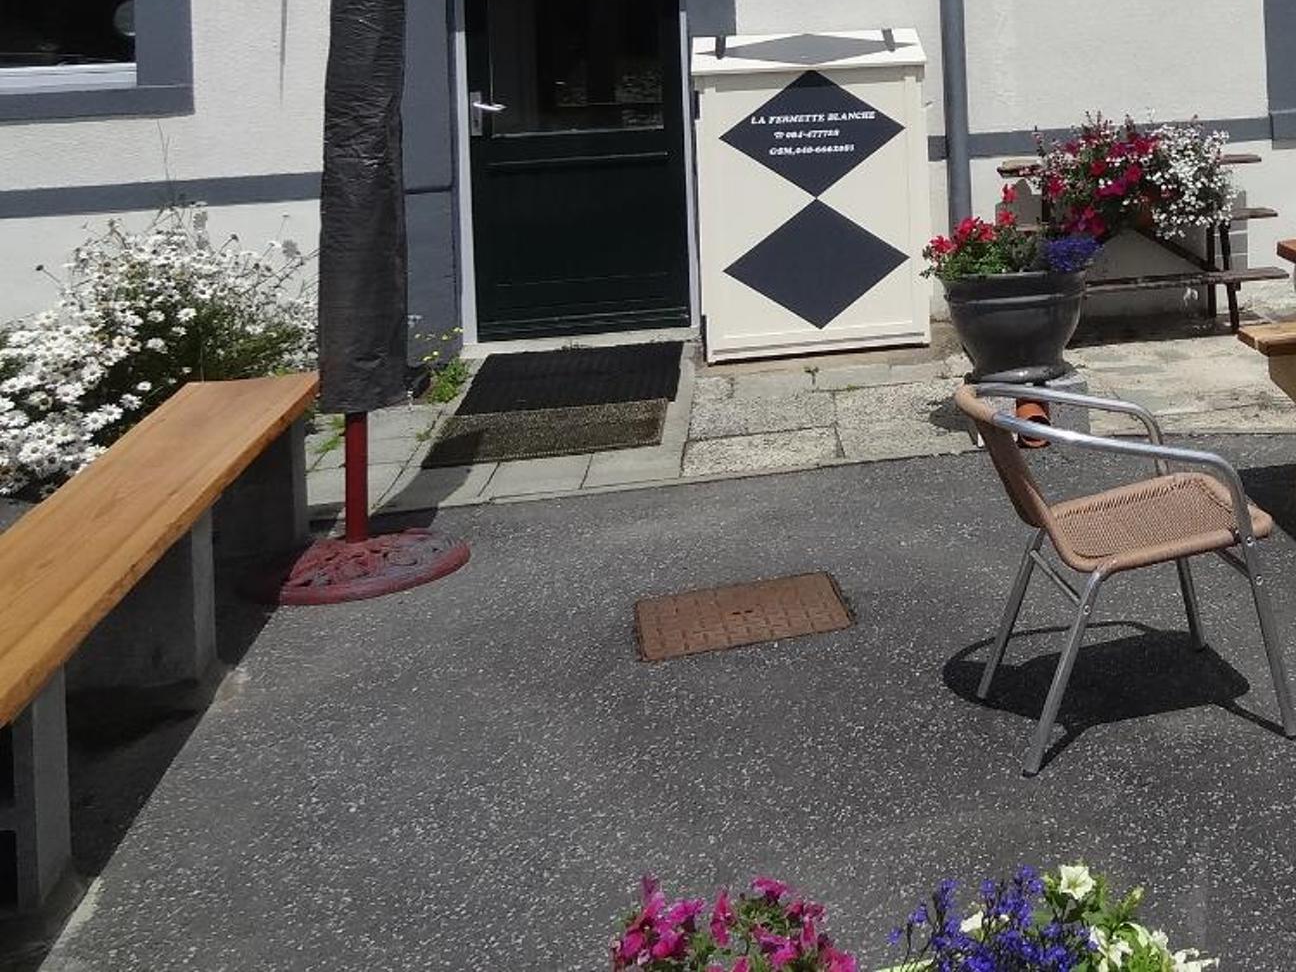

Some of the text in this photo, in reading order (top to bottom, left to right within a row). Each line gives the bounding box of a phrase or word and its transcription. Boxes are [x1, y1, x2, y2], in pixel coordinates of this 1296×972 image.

[750, 110, 876, 125] LA FERMETTE BLANCHE
